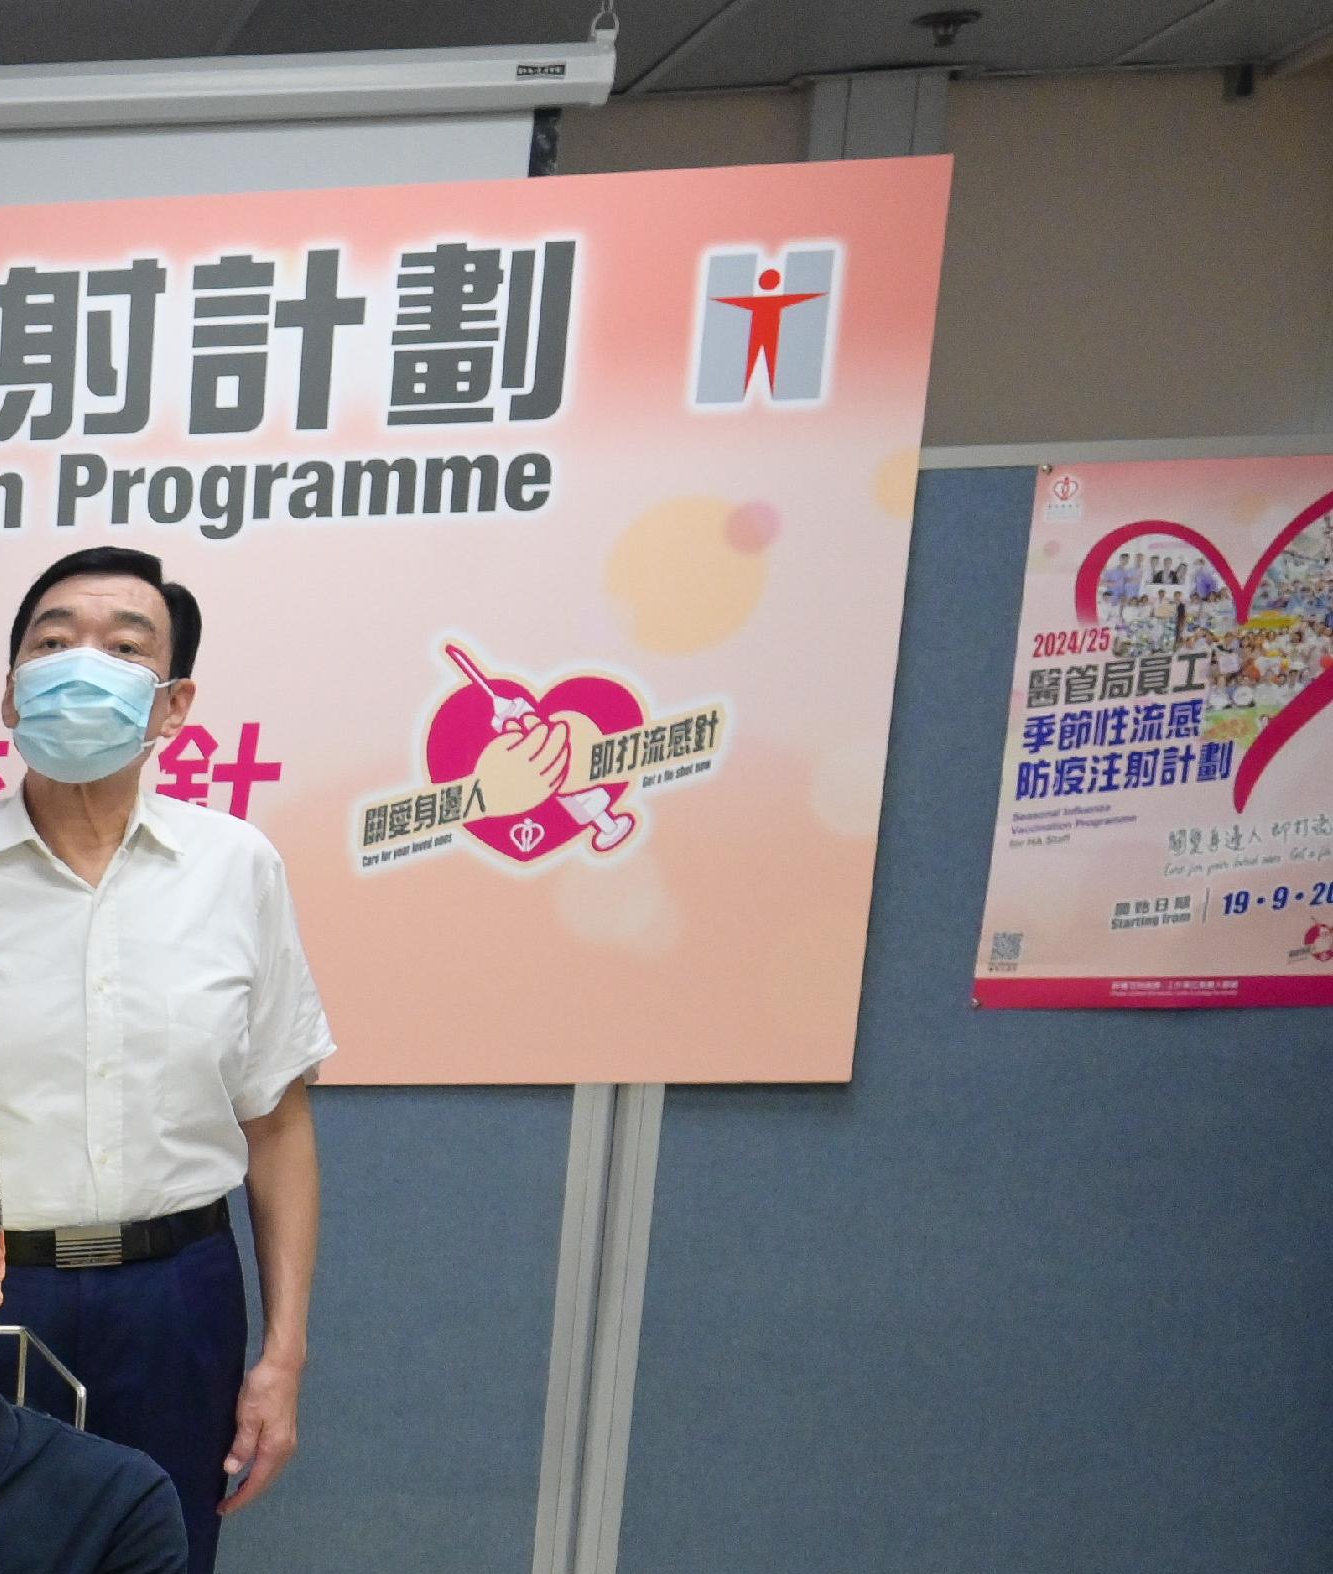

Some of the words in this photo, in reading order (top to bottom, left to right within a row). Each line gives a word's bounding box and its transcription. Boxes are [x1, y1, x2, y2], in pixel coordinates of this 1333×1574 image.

[56, 451, 552, 541] Programme
[1032, 627, 1112, 658] 2024/25
[1026, 651, 1208, 709] 醫管局員工
[588, 709, 719, 783] 即打流感針
[1022, 698, 1204, 754] 季節性流感
[1015, 740, 1235, 801] 防疫注射計劃
[362, 779, 487, 847] 關愛身邊人
